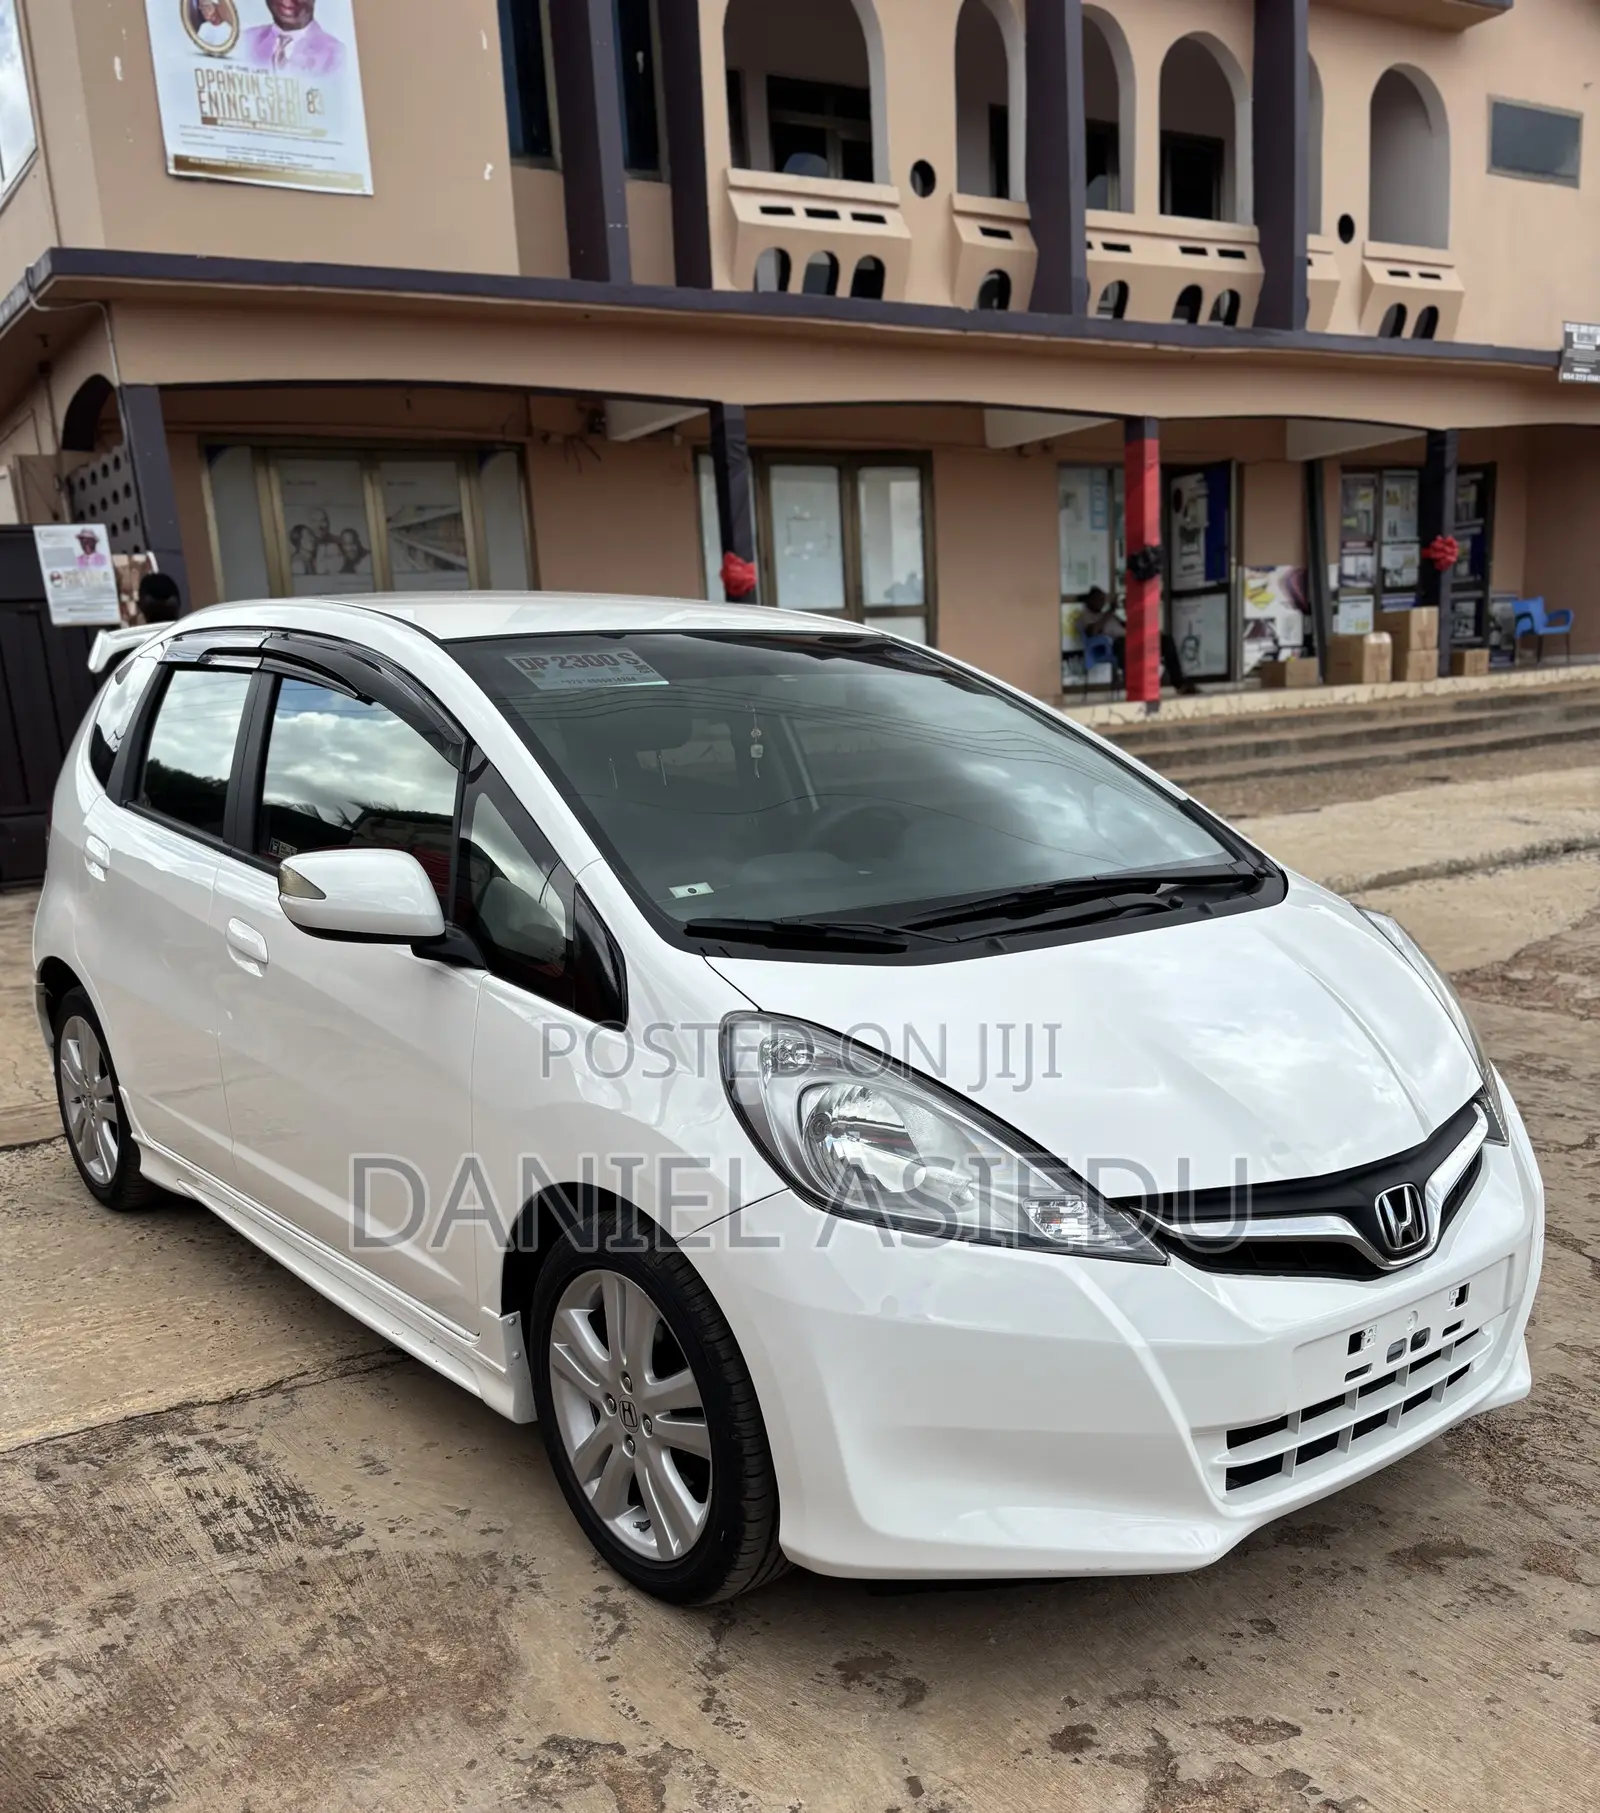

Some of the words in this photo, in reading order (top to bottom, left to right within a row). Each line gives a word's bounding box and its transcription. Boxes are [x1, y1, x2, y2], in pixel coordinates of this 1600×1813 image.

[195, 68, 260, 96] OPANYIN
[264, 76, 299, 102] SETH
[198, 90, 251, 119] ENING
[512, 656, 549, 671] DP
[551, 653, 620, 670] 2300
[617, 652, 640, 665] S
